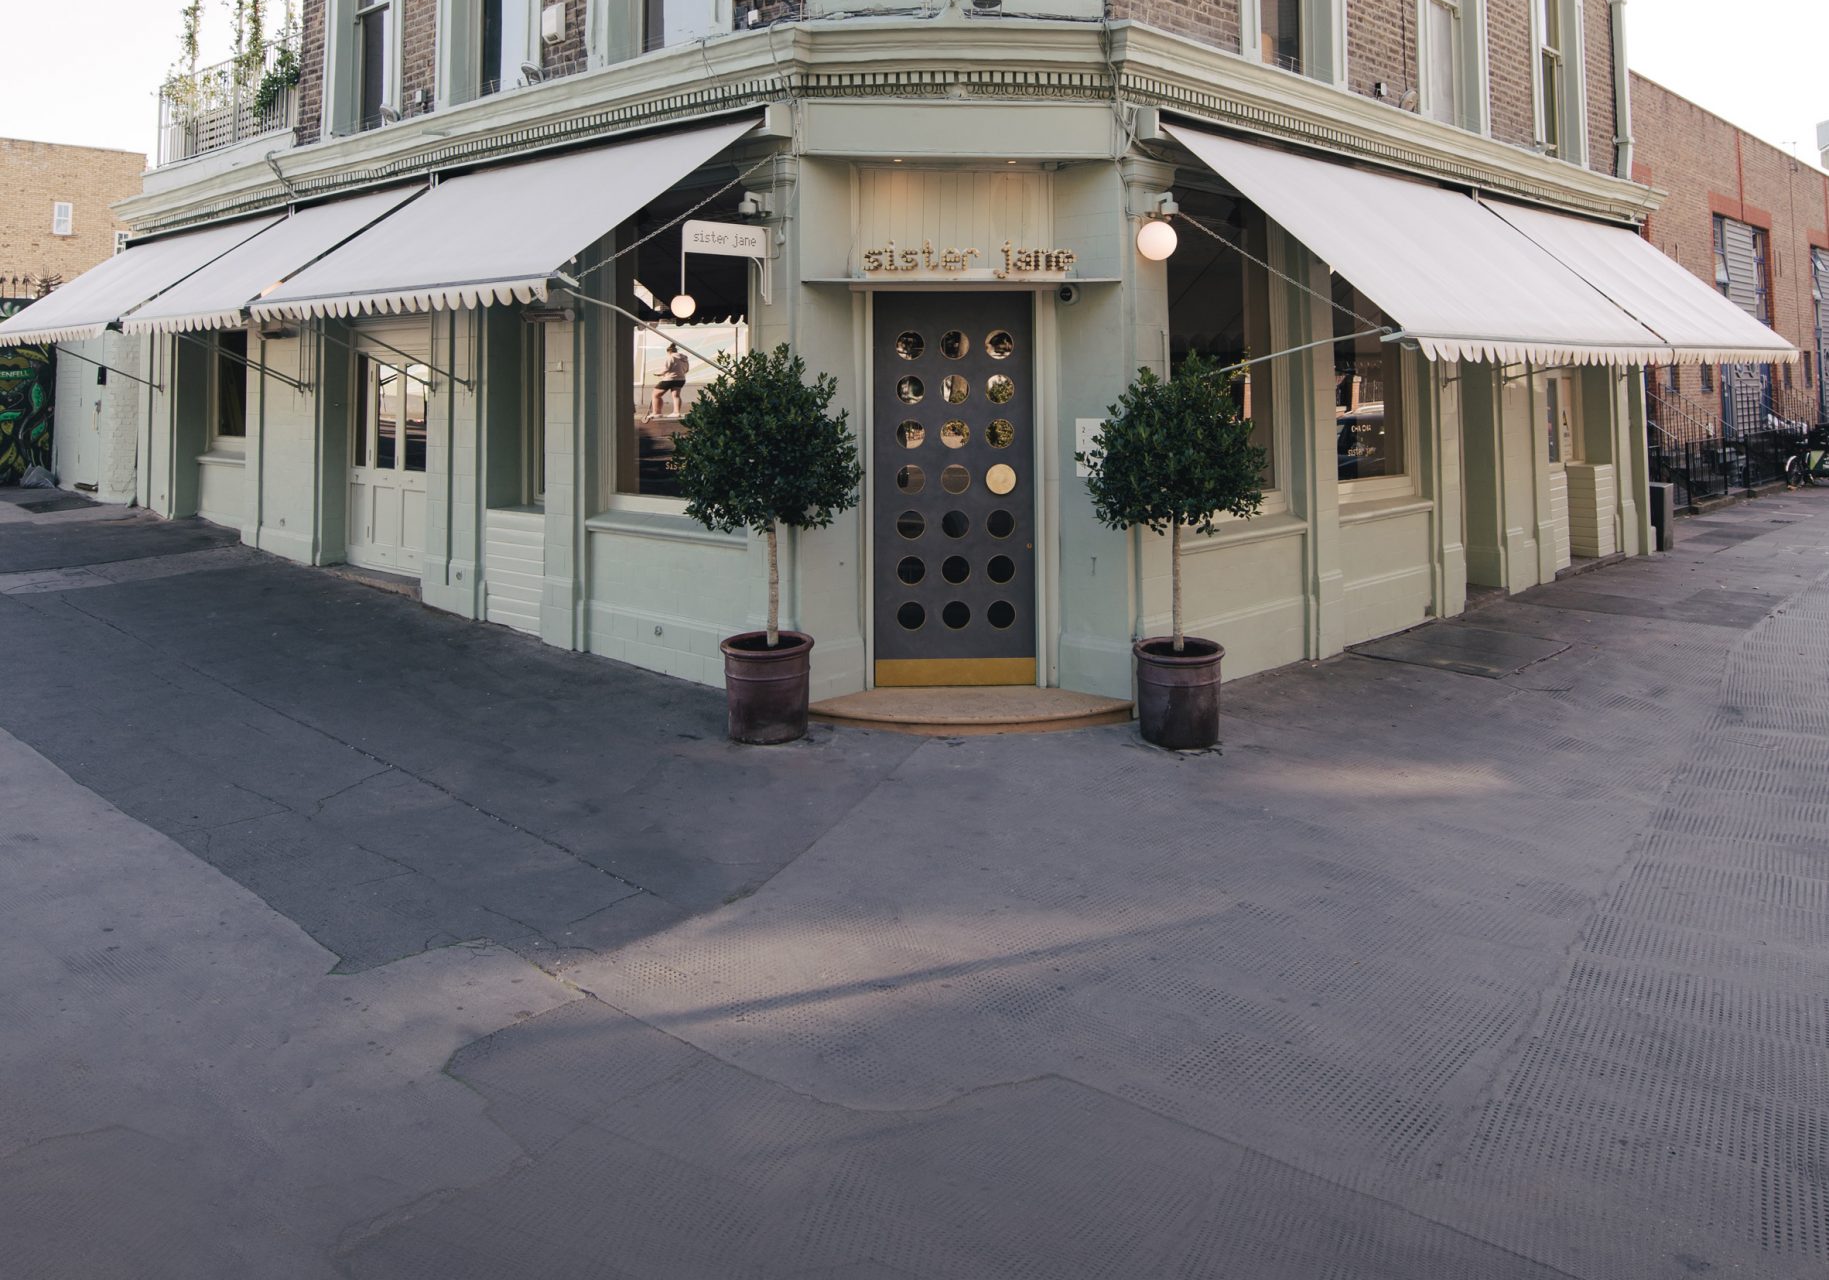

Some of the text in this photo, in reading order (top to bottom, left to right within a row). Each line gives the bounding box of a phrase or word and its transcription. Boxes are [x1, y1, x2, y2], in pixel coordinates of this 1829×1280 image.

[693, 230, 757, 248] sister jane
[863, 239, 1078, 279] sister jane
